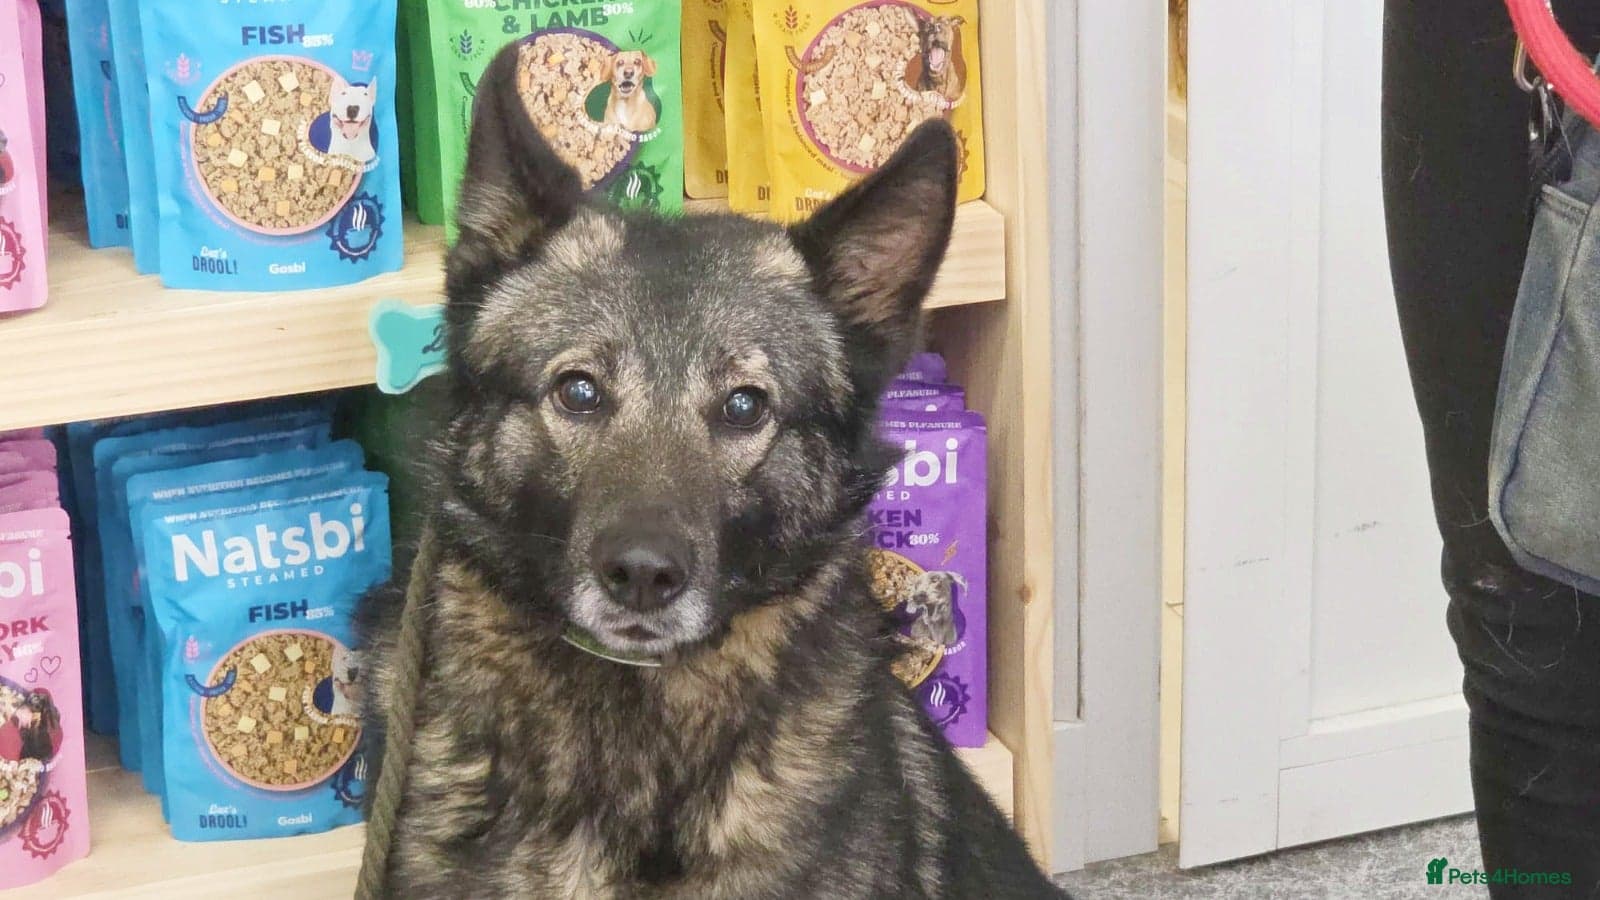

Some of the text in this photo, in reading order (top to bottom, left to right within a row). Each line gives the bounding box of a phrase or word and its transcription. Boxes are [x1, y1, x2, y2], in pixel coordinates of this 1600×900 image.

[530, 7, 609, 32] LAMB
[241, 23, 304, 46] FISH
[192, 254, 238, 275] DROOL!
[171, 502, 366, 583] Natsbi
[226, 564, 325, 589] STEAMED
[248, 598, 309, 624] FISH
